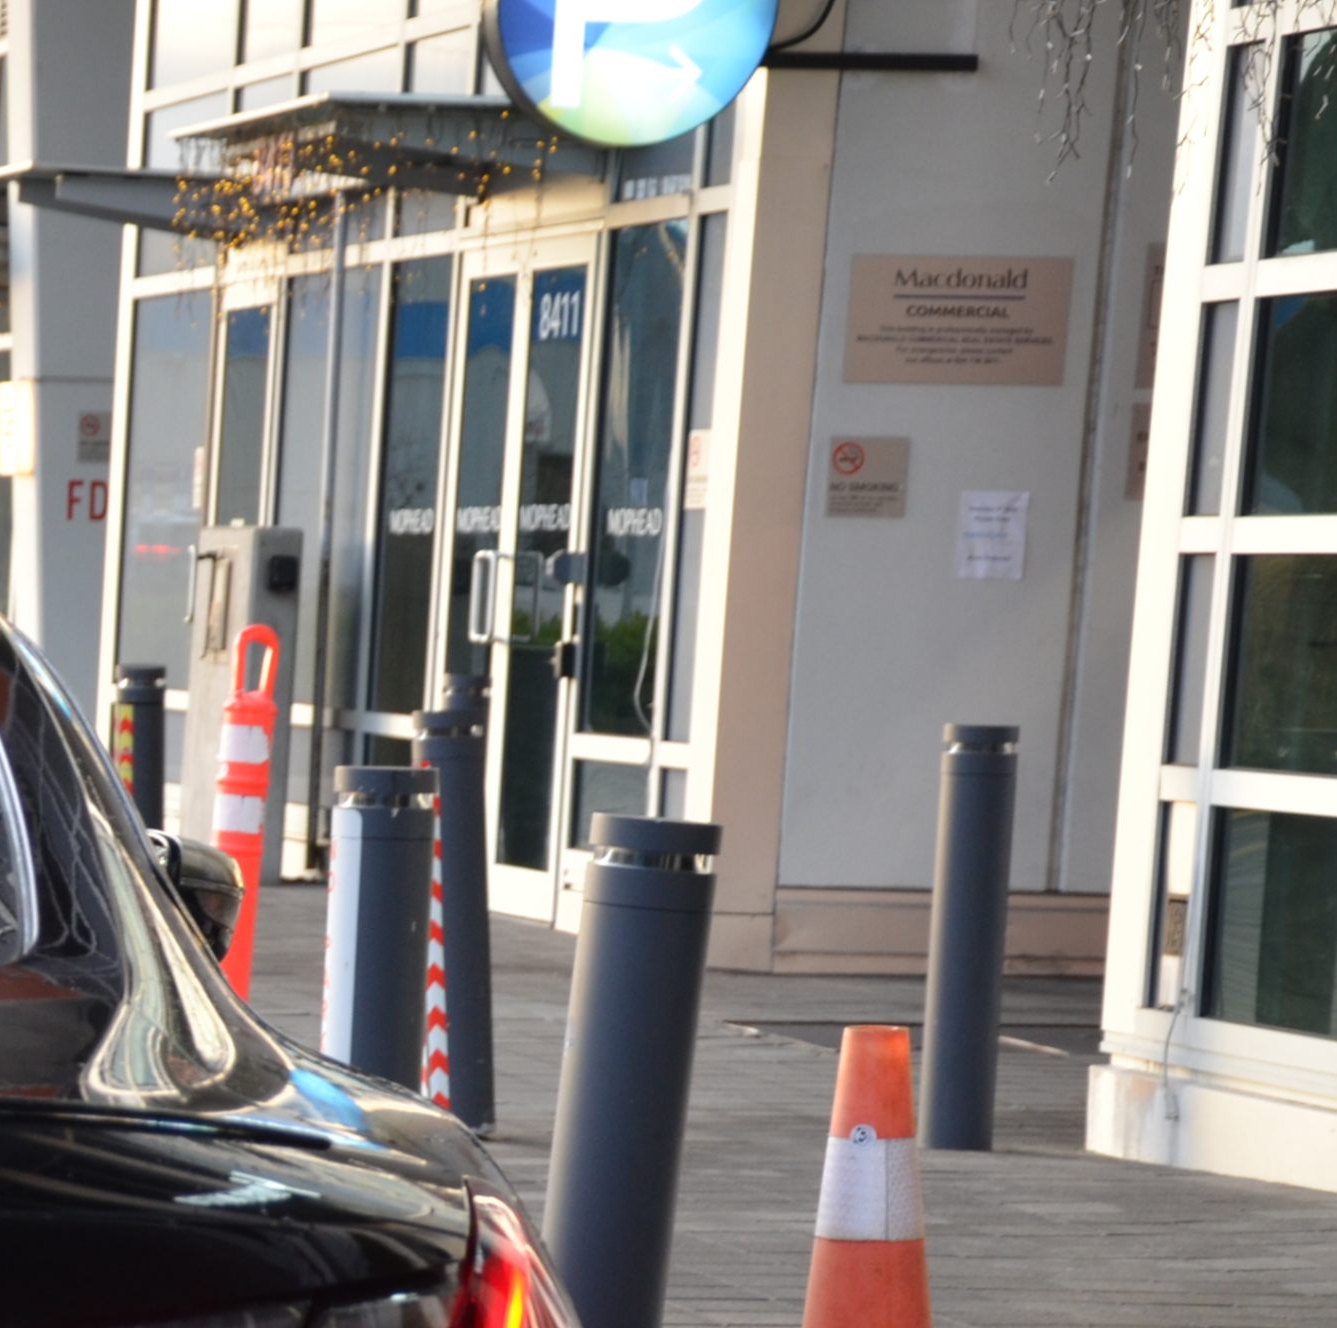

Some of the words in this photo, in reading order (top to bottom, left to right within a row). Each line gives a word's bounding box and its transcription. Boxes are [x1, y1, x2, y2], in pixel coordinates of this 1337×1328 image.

[894, 268, 1029, 290] Macdonald
[539, 289, 581, 341] 8411
[905, 304, 1010, 319] COMMERCIAL
[607, 507, 663, 536] MOPHEAD
